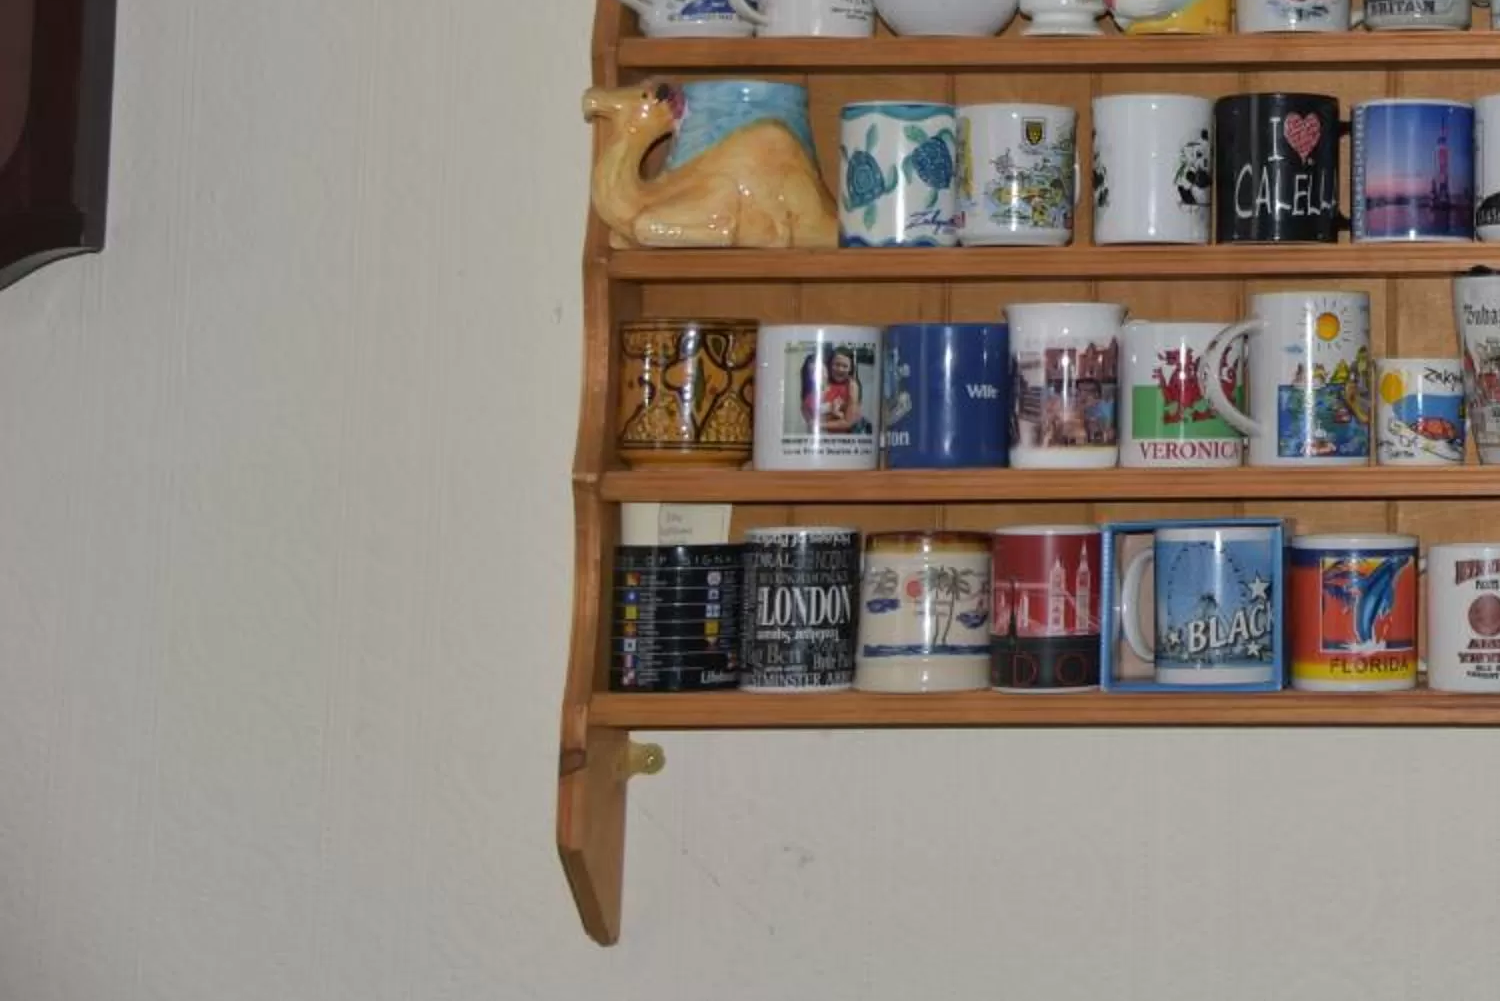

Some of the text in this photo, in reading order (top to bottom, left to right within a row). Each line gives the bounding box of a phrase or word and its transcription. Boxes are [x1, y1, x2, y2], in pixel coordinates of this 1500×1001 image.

[1234, 162, 1337, 219] CALELL
[760, 584, 851, 627] LONDON
[1328, 655, 1410, 675] FLORIDA
